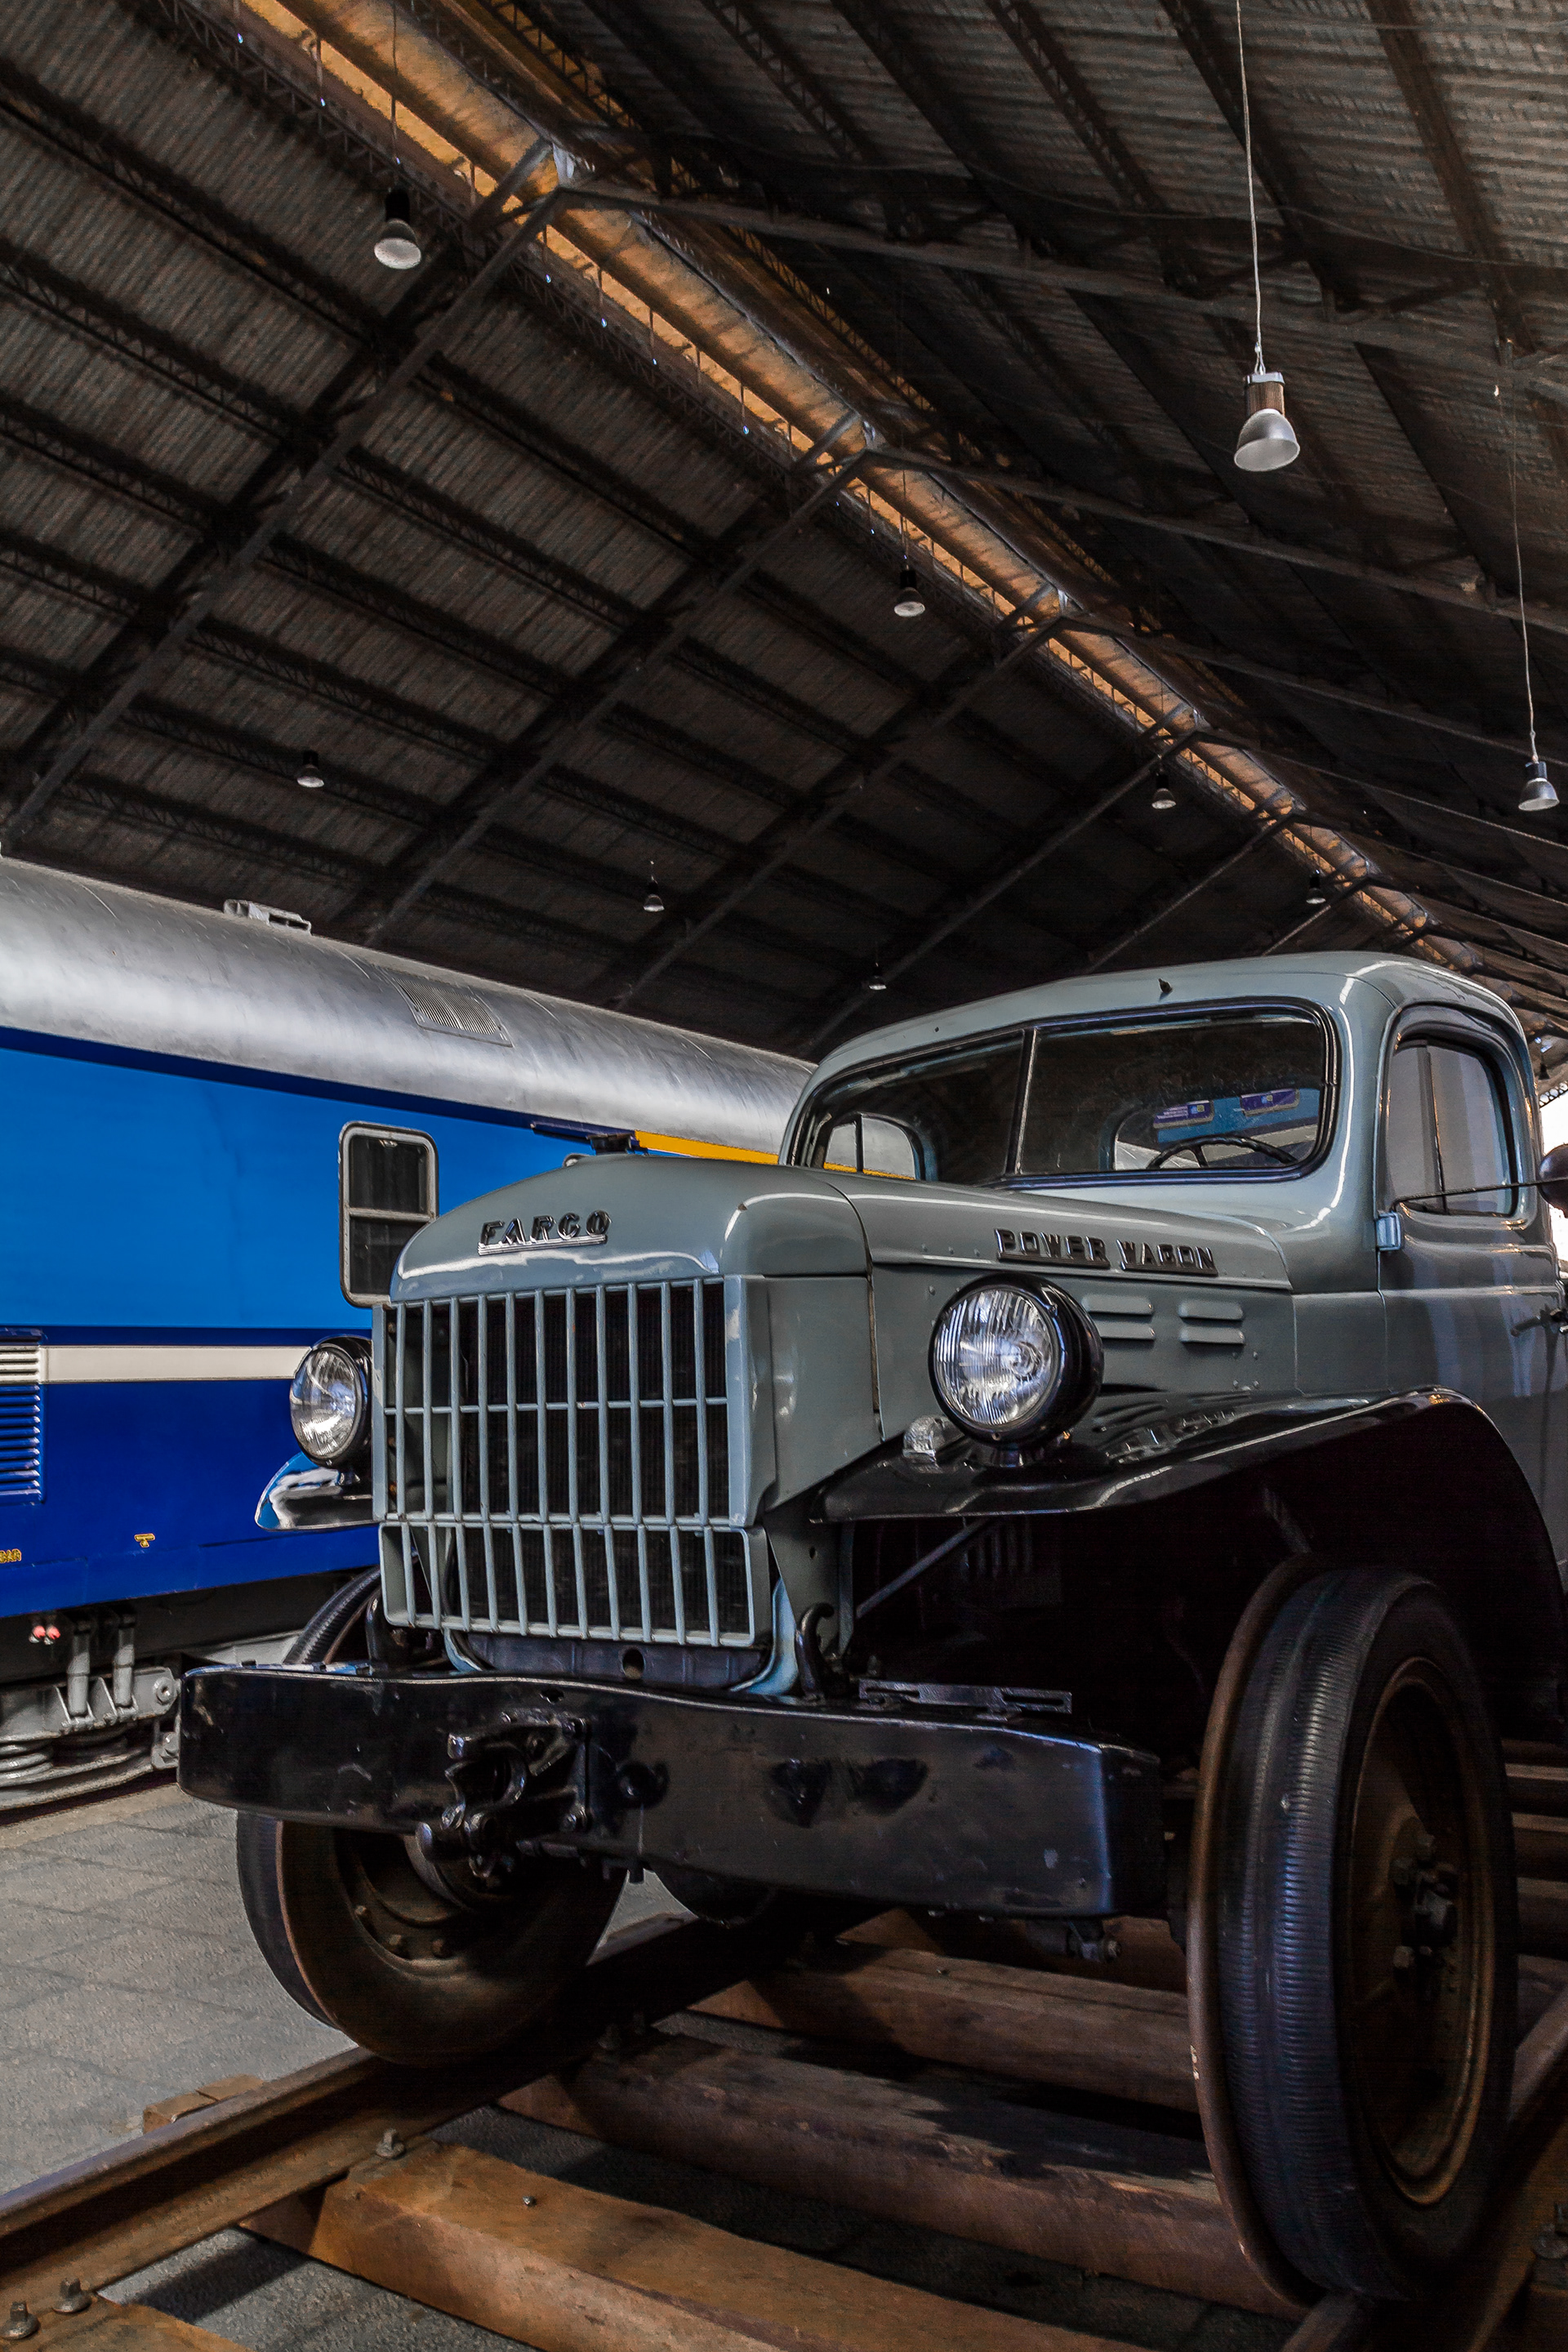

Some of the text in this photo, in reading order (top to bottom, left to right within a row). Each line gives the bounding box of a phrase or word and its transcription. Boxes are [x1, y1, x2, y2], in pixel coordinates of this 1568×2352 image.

[479, 1209, 612, 1248] FARGO
[995, 1228, 1216, 1272] POWER WAGON
